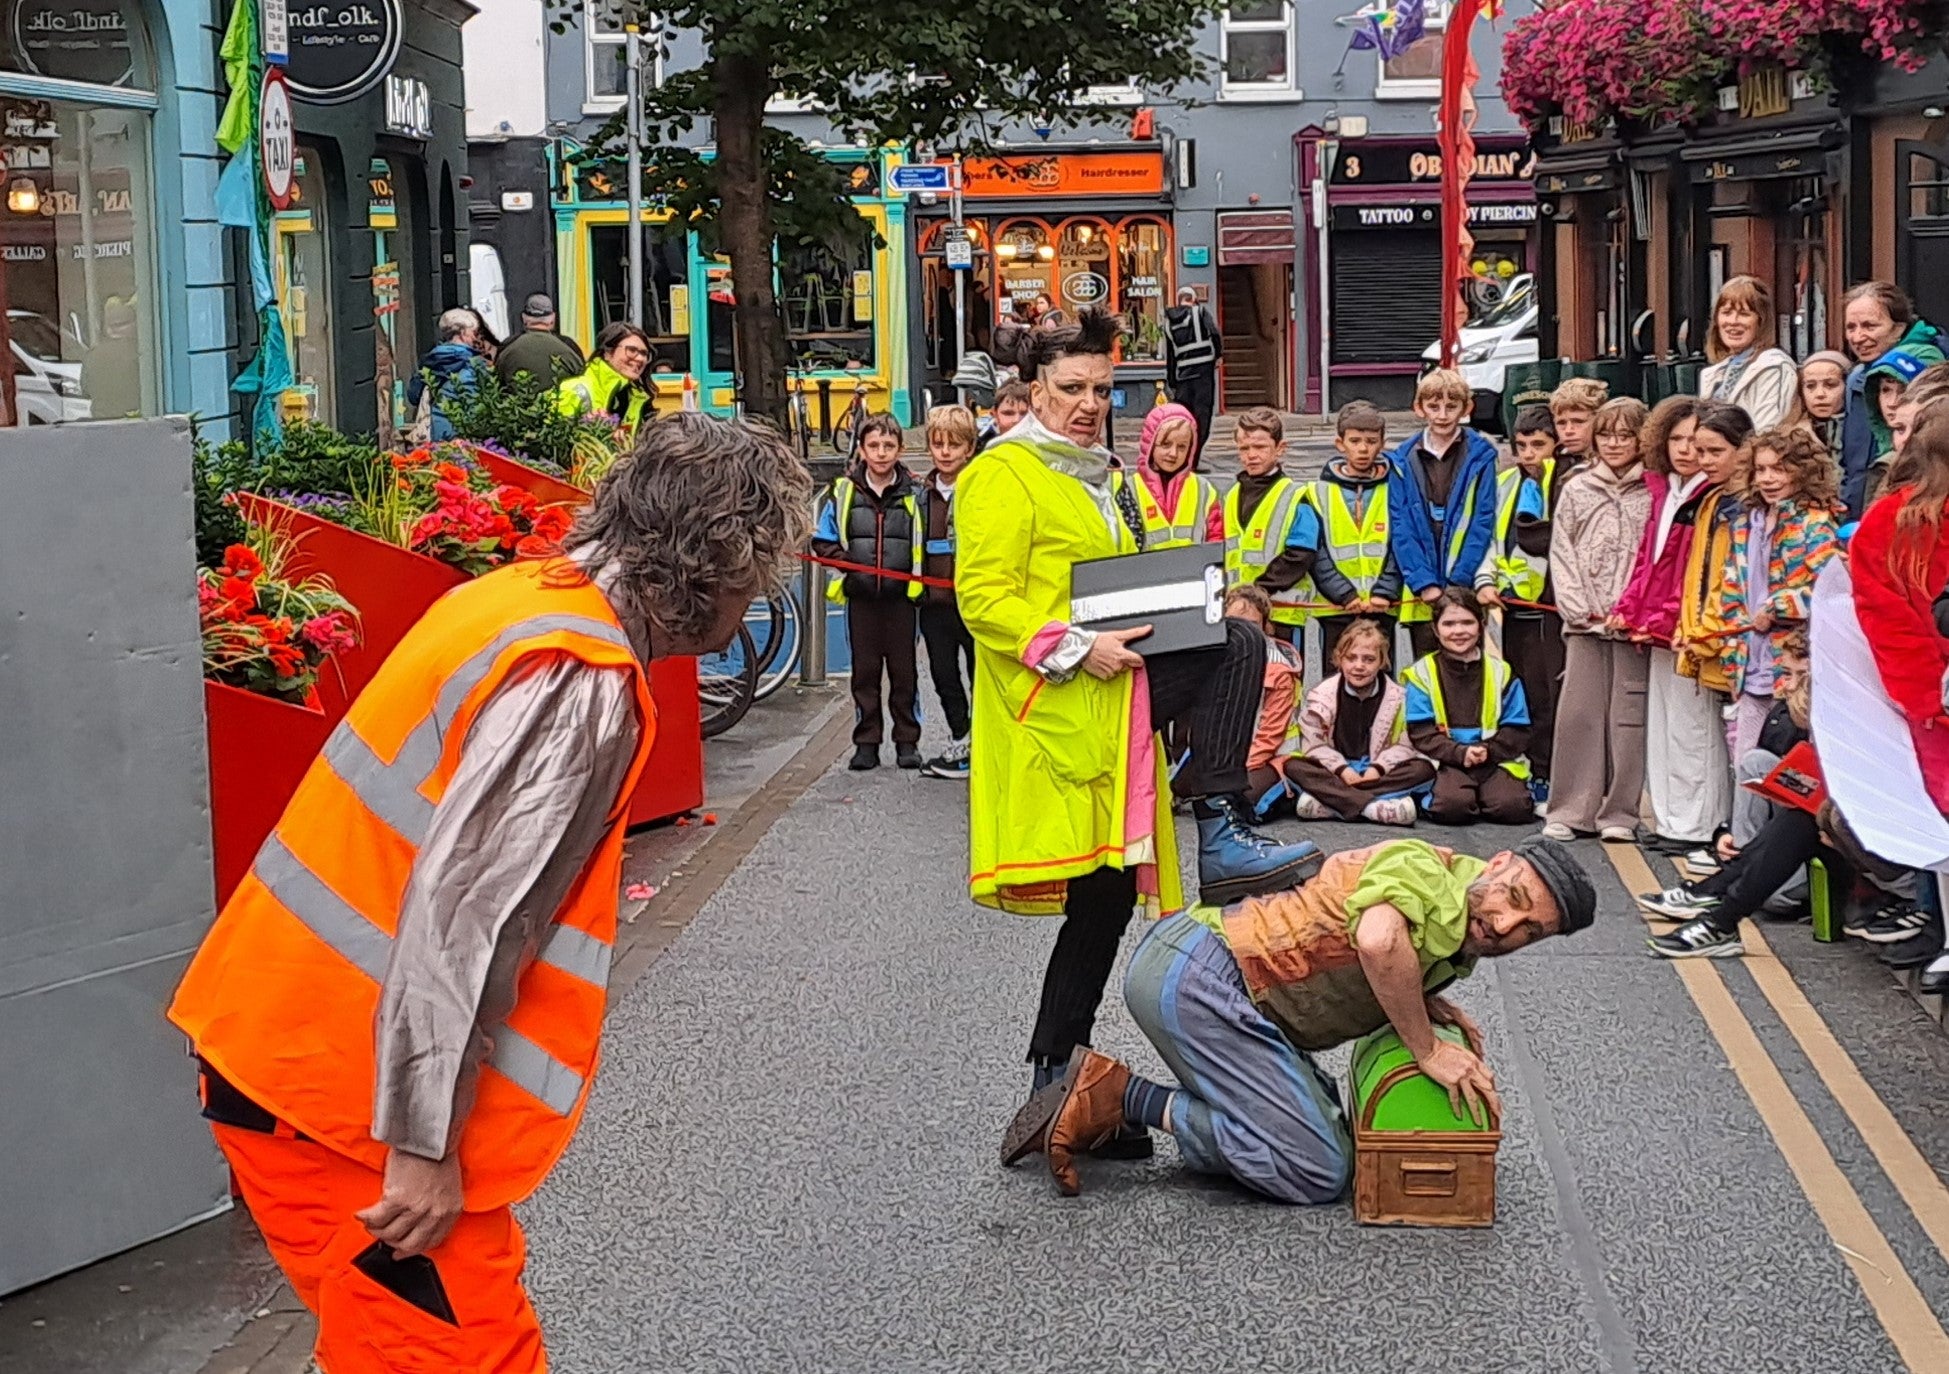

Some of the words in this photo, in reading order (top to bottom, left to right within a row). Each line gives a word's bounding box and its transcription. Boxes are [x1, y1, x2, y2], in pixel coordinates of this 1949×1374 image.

[266, 137, 289, 173] TAXI
[1081, 168, 1149, 177] Hairdresser
[1346, 156, 1360, 178] 3
[1359, 208, 1414, 224] TATTOO
[1480, 205, 1537, 221] PIERCIN
[1131, 276, 1158, 286] HAIR
[1127, 287, 1163, 297] SALON
